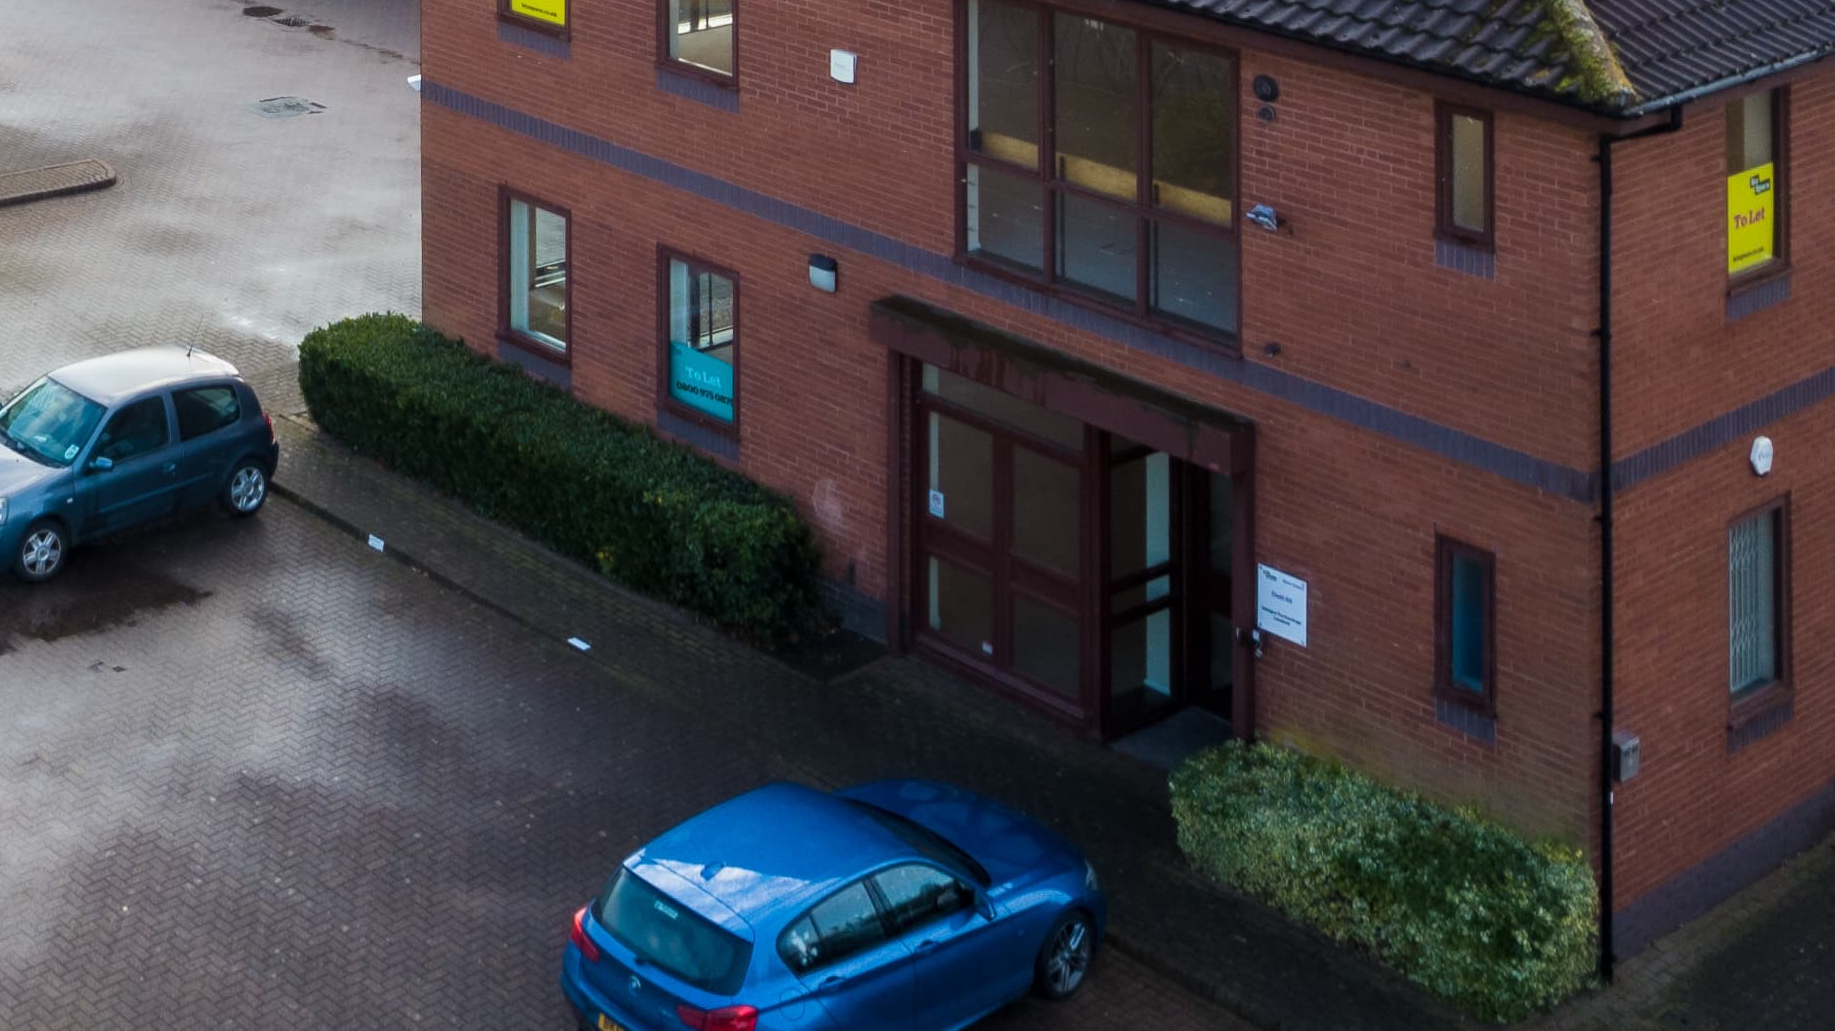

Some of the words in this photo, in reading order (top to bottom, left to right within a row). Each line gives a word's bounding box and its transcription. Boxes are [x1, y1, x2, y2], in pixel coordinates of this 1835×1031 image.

[1734, 214, 1748, 230] To
[1749, 207, 1765, 225] Let
[685, 365, 702, 381] To
[702, 371, 721, 388] Let
